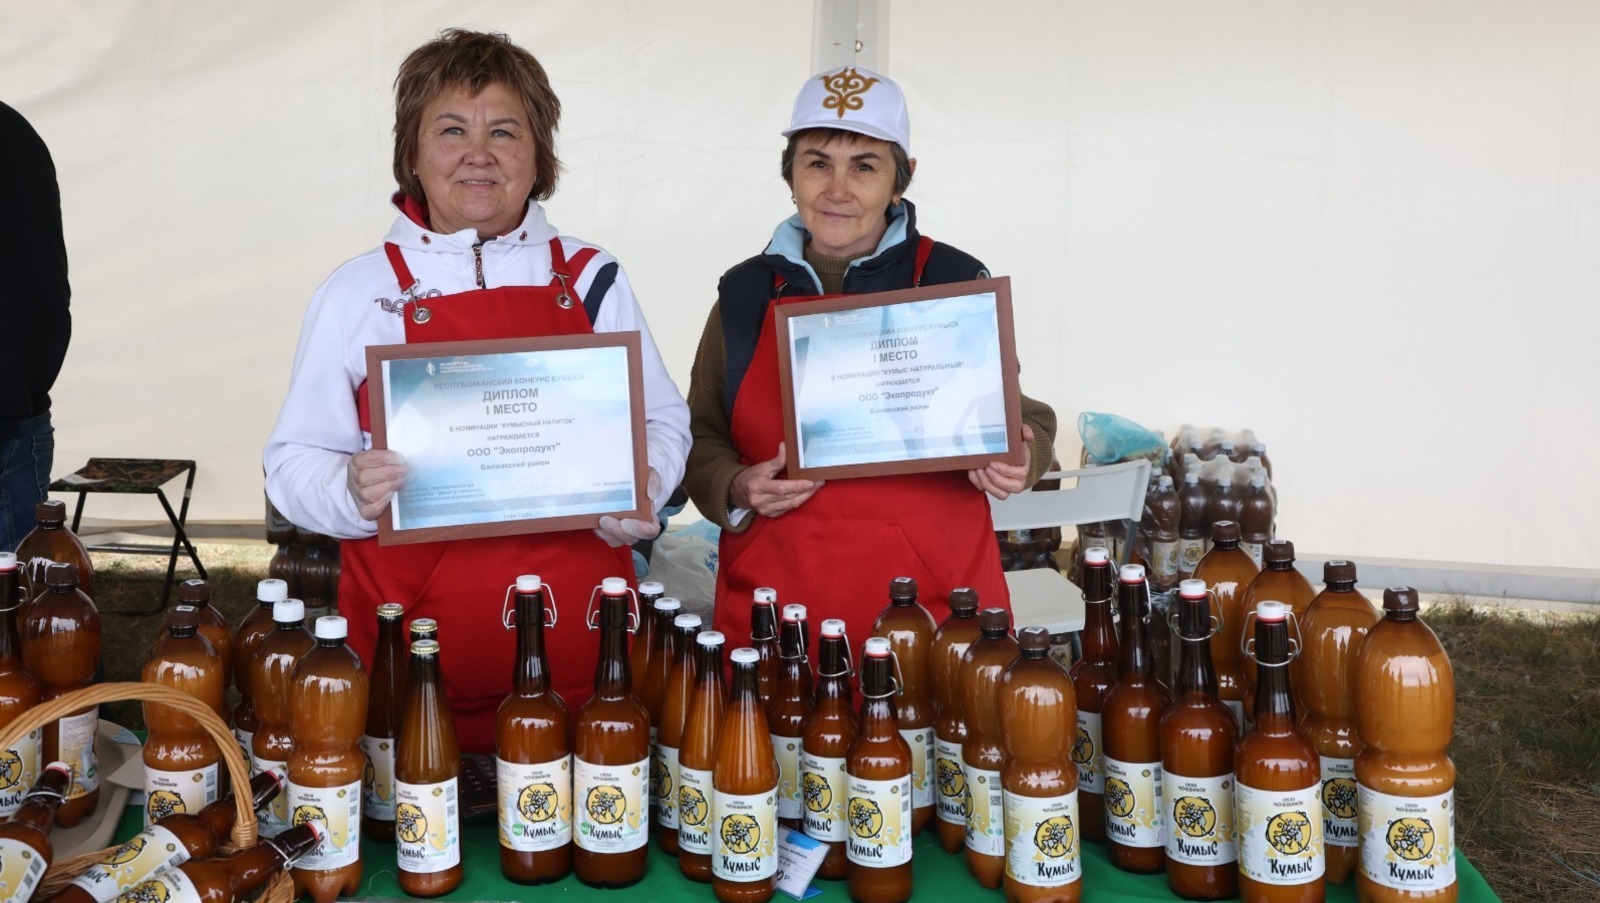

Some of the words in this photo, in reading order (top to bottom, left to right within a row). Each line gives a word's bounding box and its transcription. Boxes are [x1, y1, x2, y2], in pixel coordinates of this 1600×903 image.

[870, 336, 918, 351] ДИПЛОМ
[879, 350, 918, 362] МЕСТО
[837, 370, 879, 380] НОМИНАЦИИ
[880, 366, 909, 376] "КУМЫС
[909, 361, 964, 373] НАТУРАЛЬНЫЙ"
[434, 376, 513, 390] РЕСПУБЛИКАНСКИЙ
[514, 375, 550, 385] КОНКУРС
[551, 374, 585, 383] КУМЫСА
[875, 378, 921, 387] НАГРАЖДАЕТСЯ
[482, 387, 539, 403] ДИПЛОМ
[858, 392, 879, 402] ООО
[880, 387, 939, 400] "Экопродукт"
[493, 402, 538, 415] МЕСТО
[869, 406, 909, 414] Баймакский
[909, 404, 930, 412] район
[455, 423, 498, 432] НОМИНАЦИИ
[499, 419, 541, 429] "КУМЫСНЫЙ
[542, 418, 576, 426] НАПИТОК"
[487, 432, 540, 442] НАГРАЖДАЕТСЯ
[467, 447, 491, 457] ООО
[493, 442, 561, 455] "Экопродукт"
[480, 460, 526, 471] Баймакский
[527, 459, 550, 468] район
